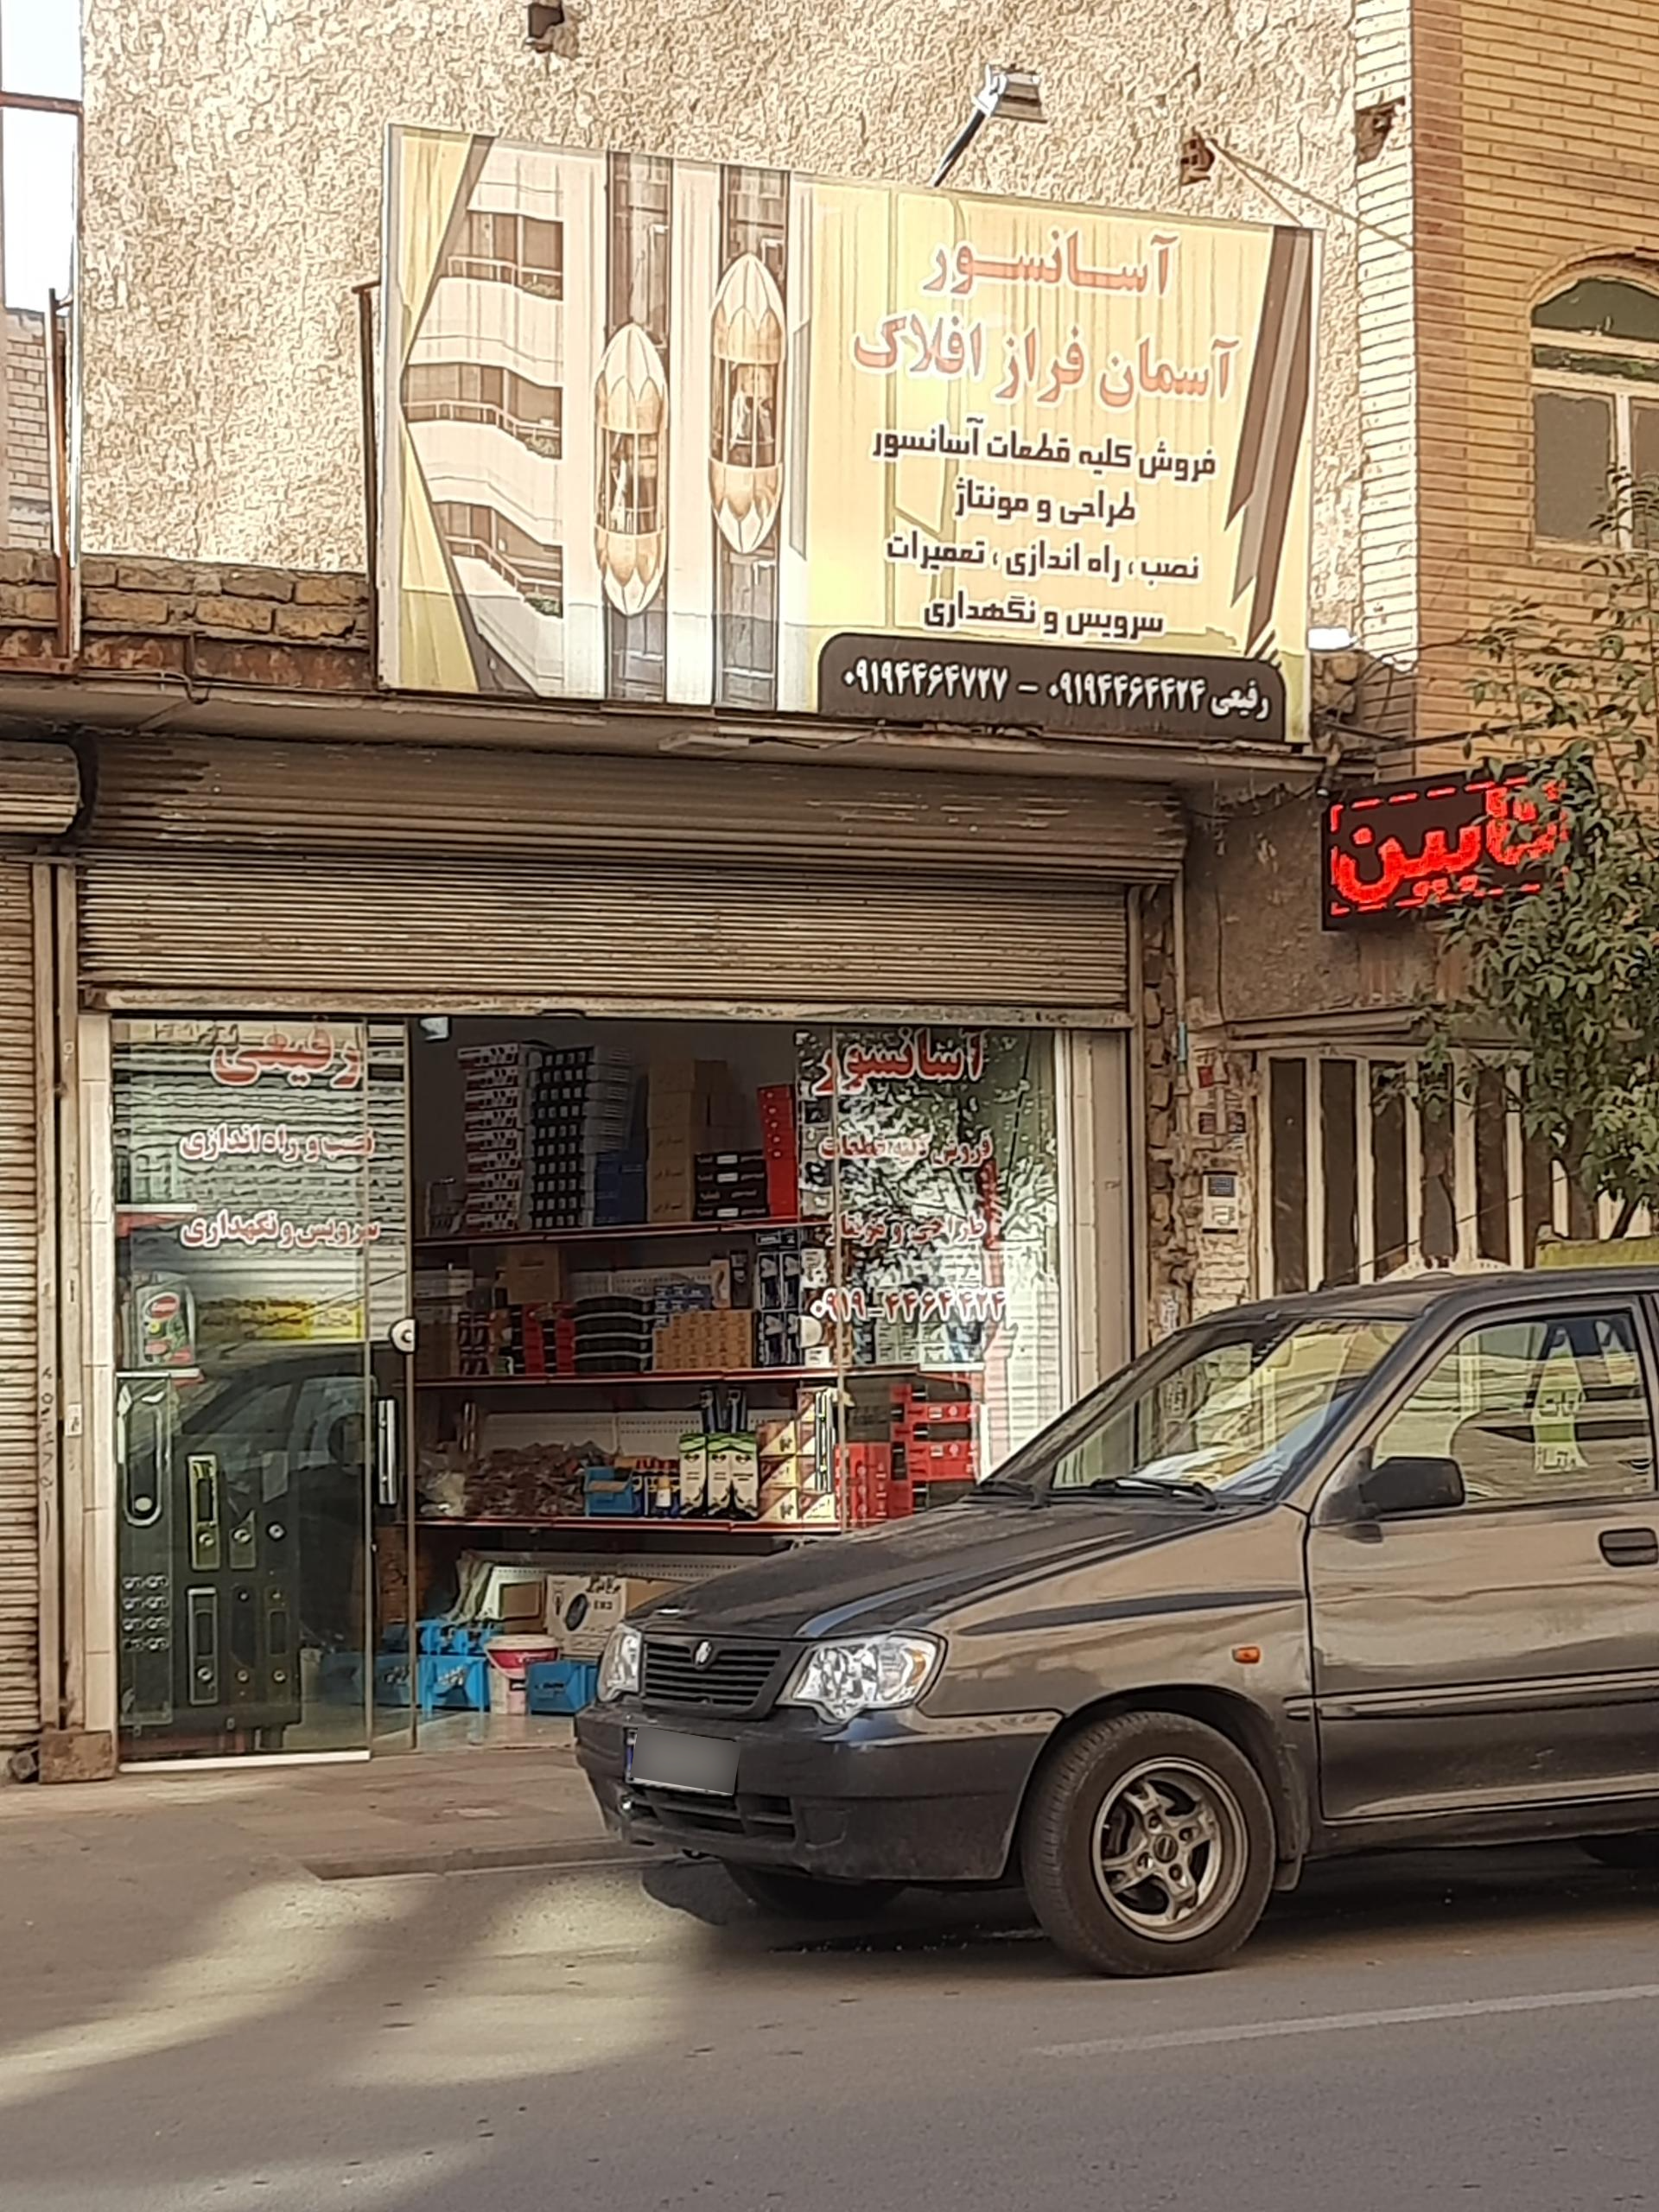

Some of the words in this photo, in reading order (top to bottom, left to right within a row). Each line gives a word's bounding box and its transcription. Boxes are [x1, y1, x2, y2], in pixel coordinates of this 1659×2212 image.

[923, 231, 1179, 295] آسانسور
[995, 326, 1085, 403] فراز
[1100, 337, 1239, 408] آسمان
[873, 418, 984, 458] آسانسور
[987, 430, 1071, 464] قطعات
[1078, 438, 1133, 476] کلیه
[1140, 442, 1216, 482] فروش
[956, 479, 1028, 518] مونتاژ
[1037, 497, 1052, 523] و
[1059, 491, 1136, 529] طراحی
[887, 532, 985, 570] تعمیرات
[1006, 540, 1080, 576] اندازی
[1087, 546, 1121, 582] راه
[1141, 556, 1199, 588] نصب
[924, 590, 1036, 628] نگهداری
[1043, 610, 1058, 633] و
[1066, 612, 1163, 639] سرویس
[1211, 680, 1269, 721] رفیعی
[812, 1027, 990, 1095] آسانسور
